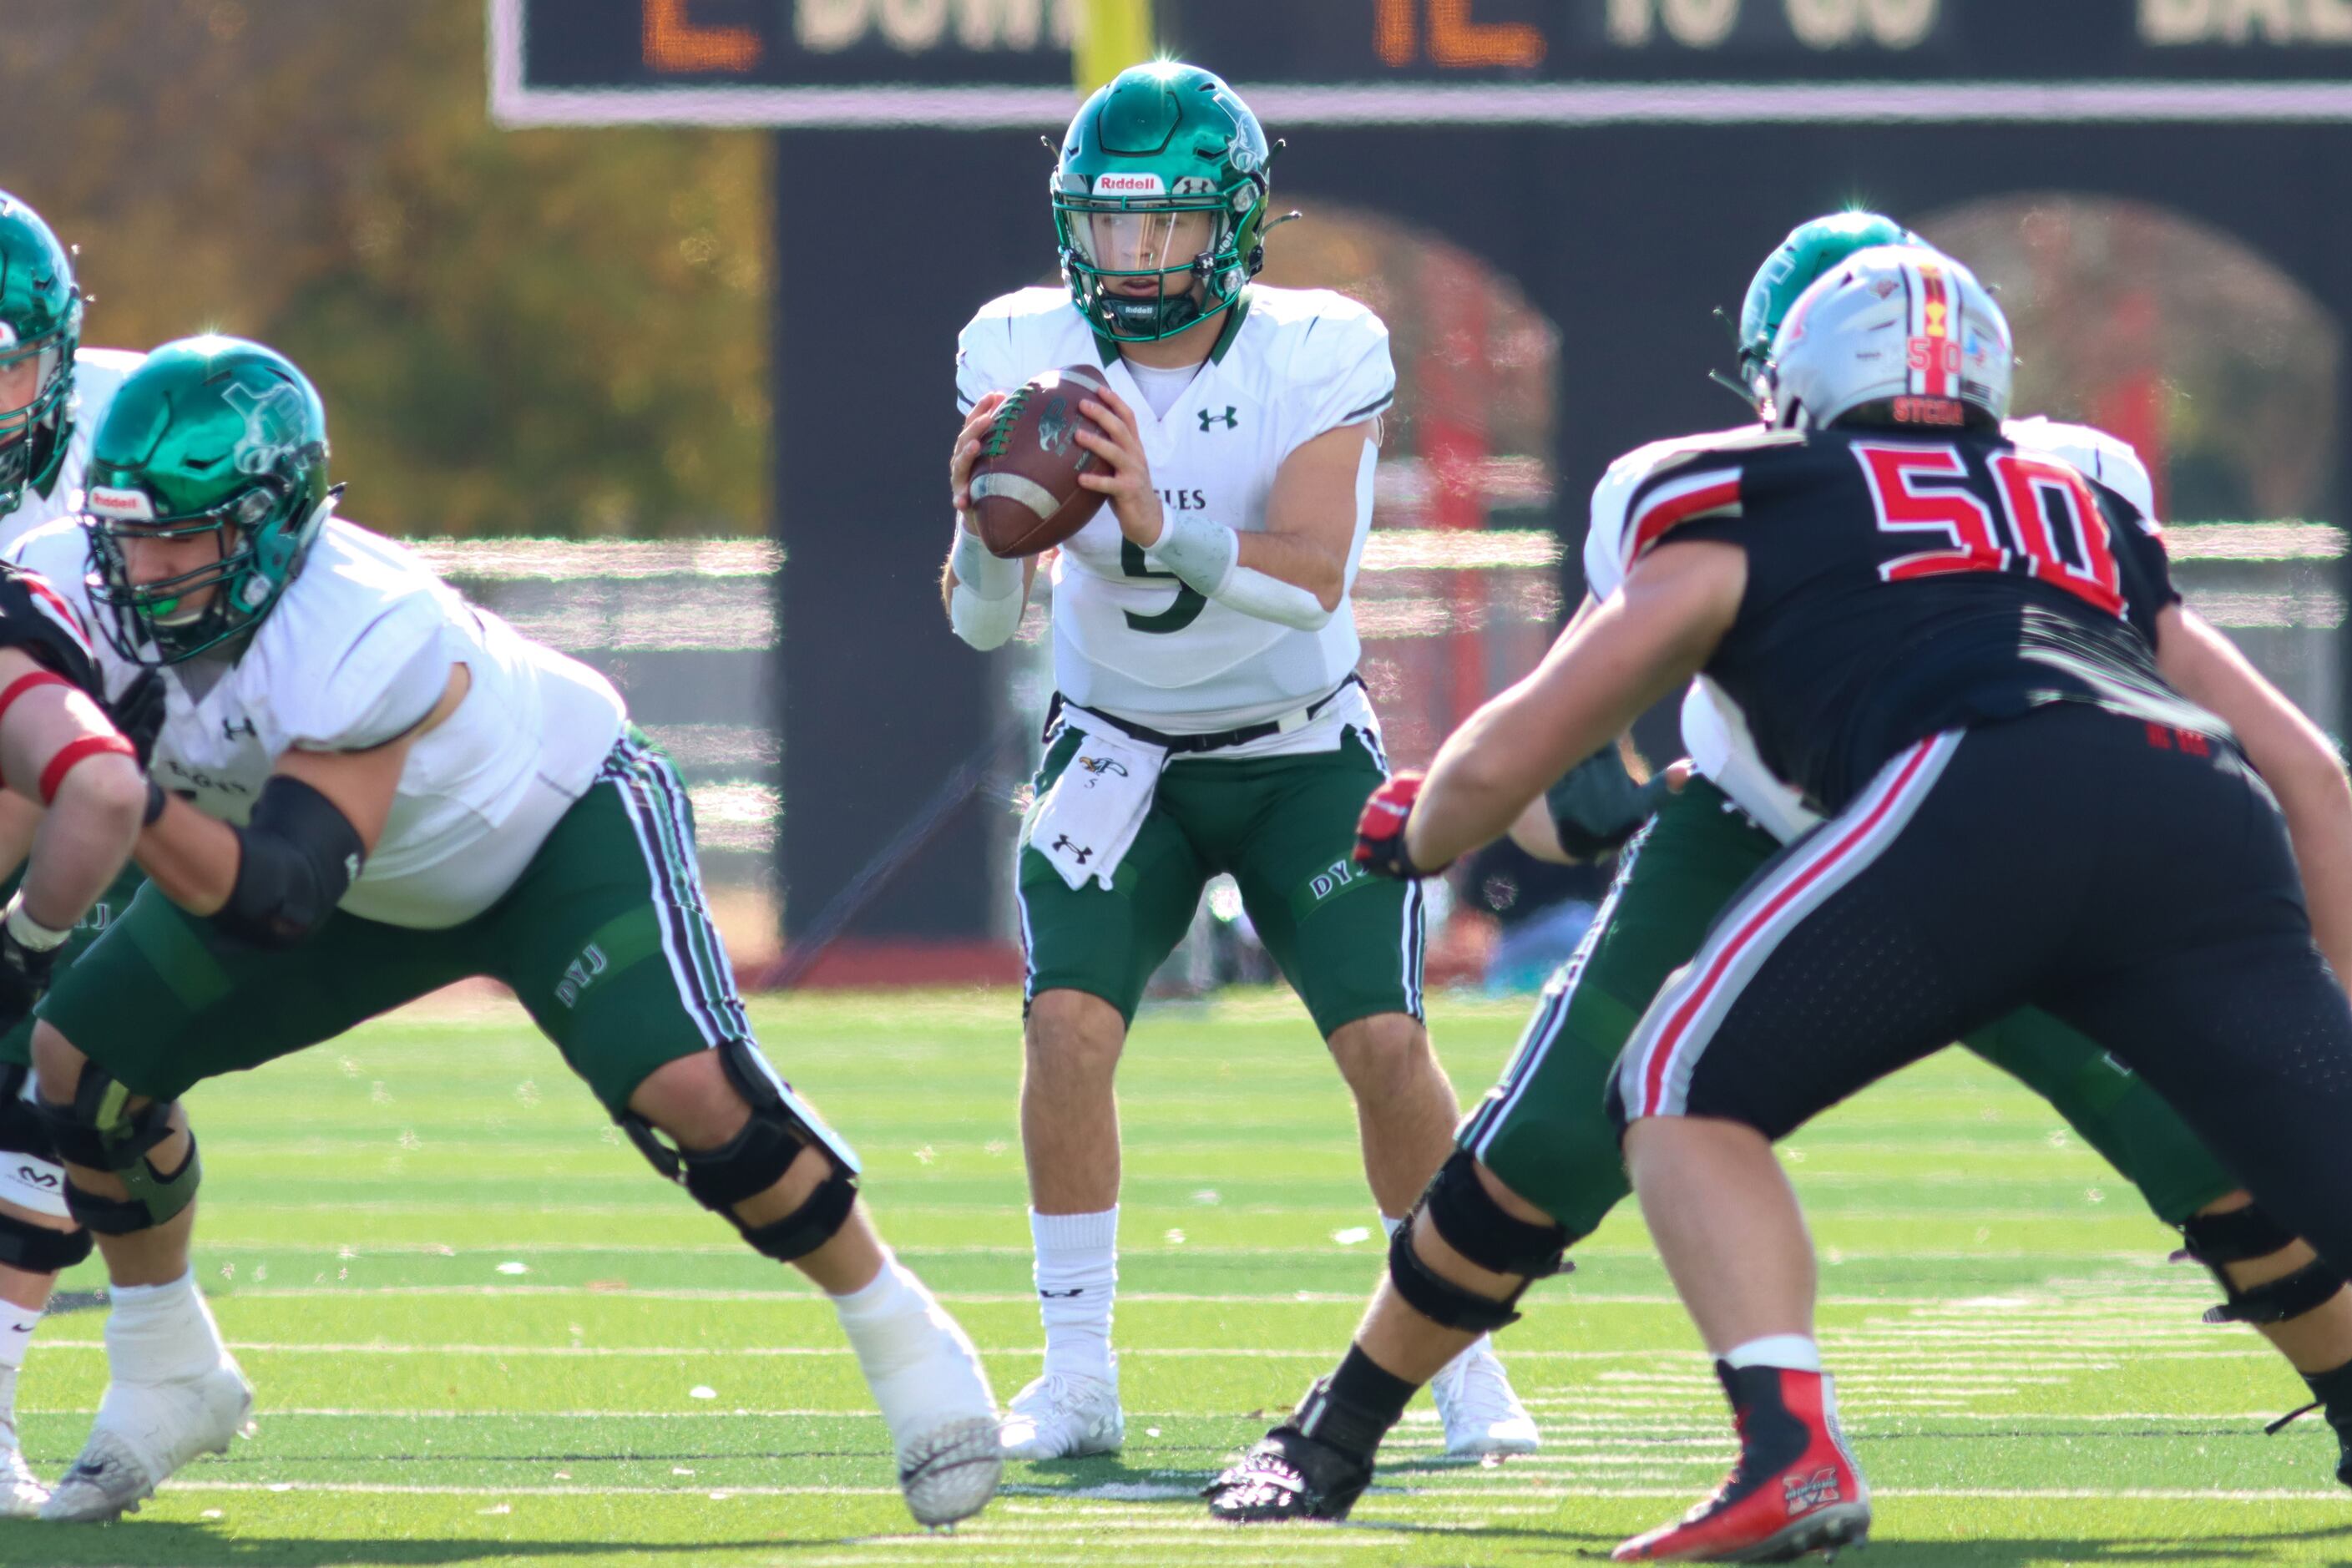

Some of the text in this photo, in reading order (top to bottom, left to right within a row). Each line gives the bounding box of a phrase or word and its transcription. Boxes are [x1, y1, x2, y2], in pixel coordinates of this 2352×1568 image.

[1101, 177, 1155, 190] Riddell
[1125, 306, 1153, 315] Riddell
[1849, 441, 2128, 621] 50
[1120, 534, 1208, 635] 5
[1308, 859, 1369, 900] DY
[554, 942, 607, 1009] DYJ
